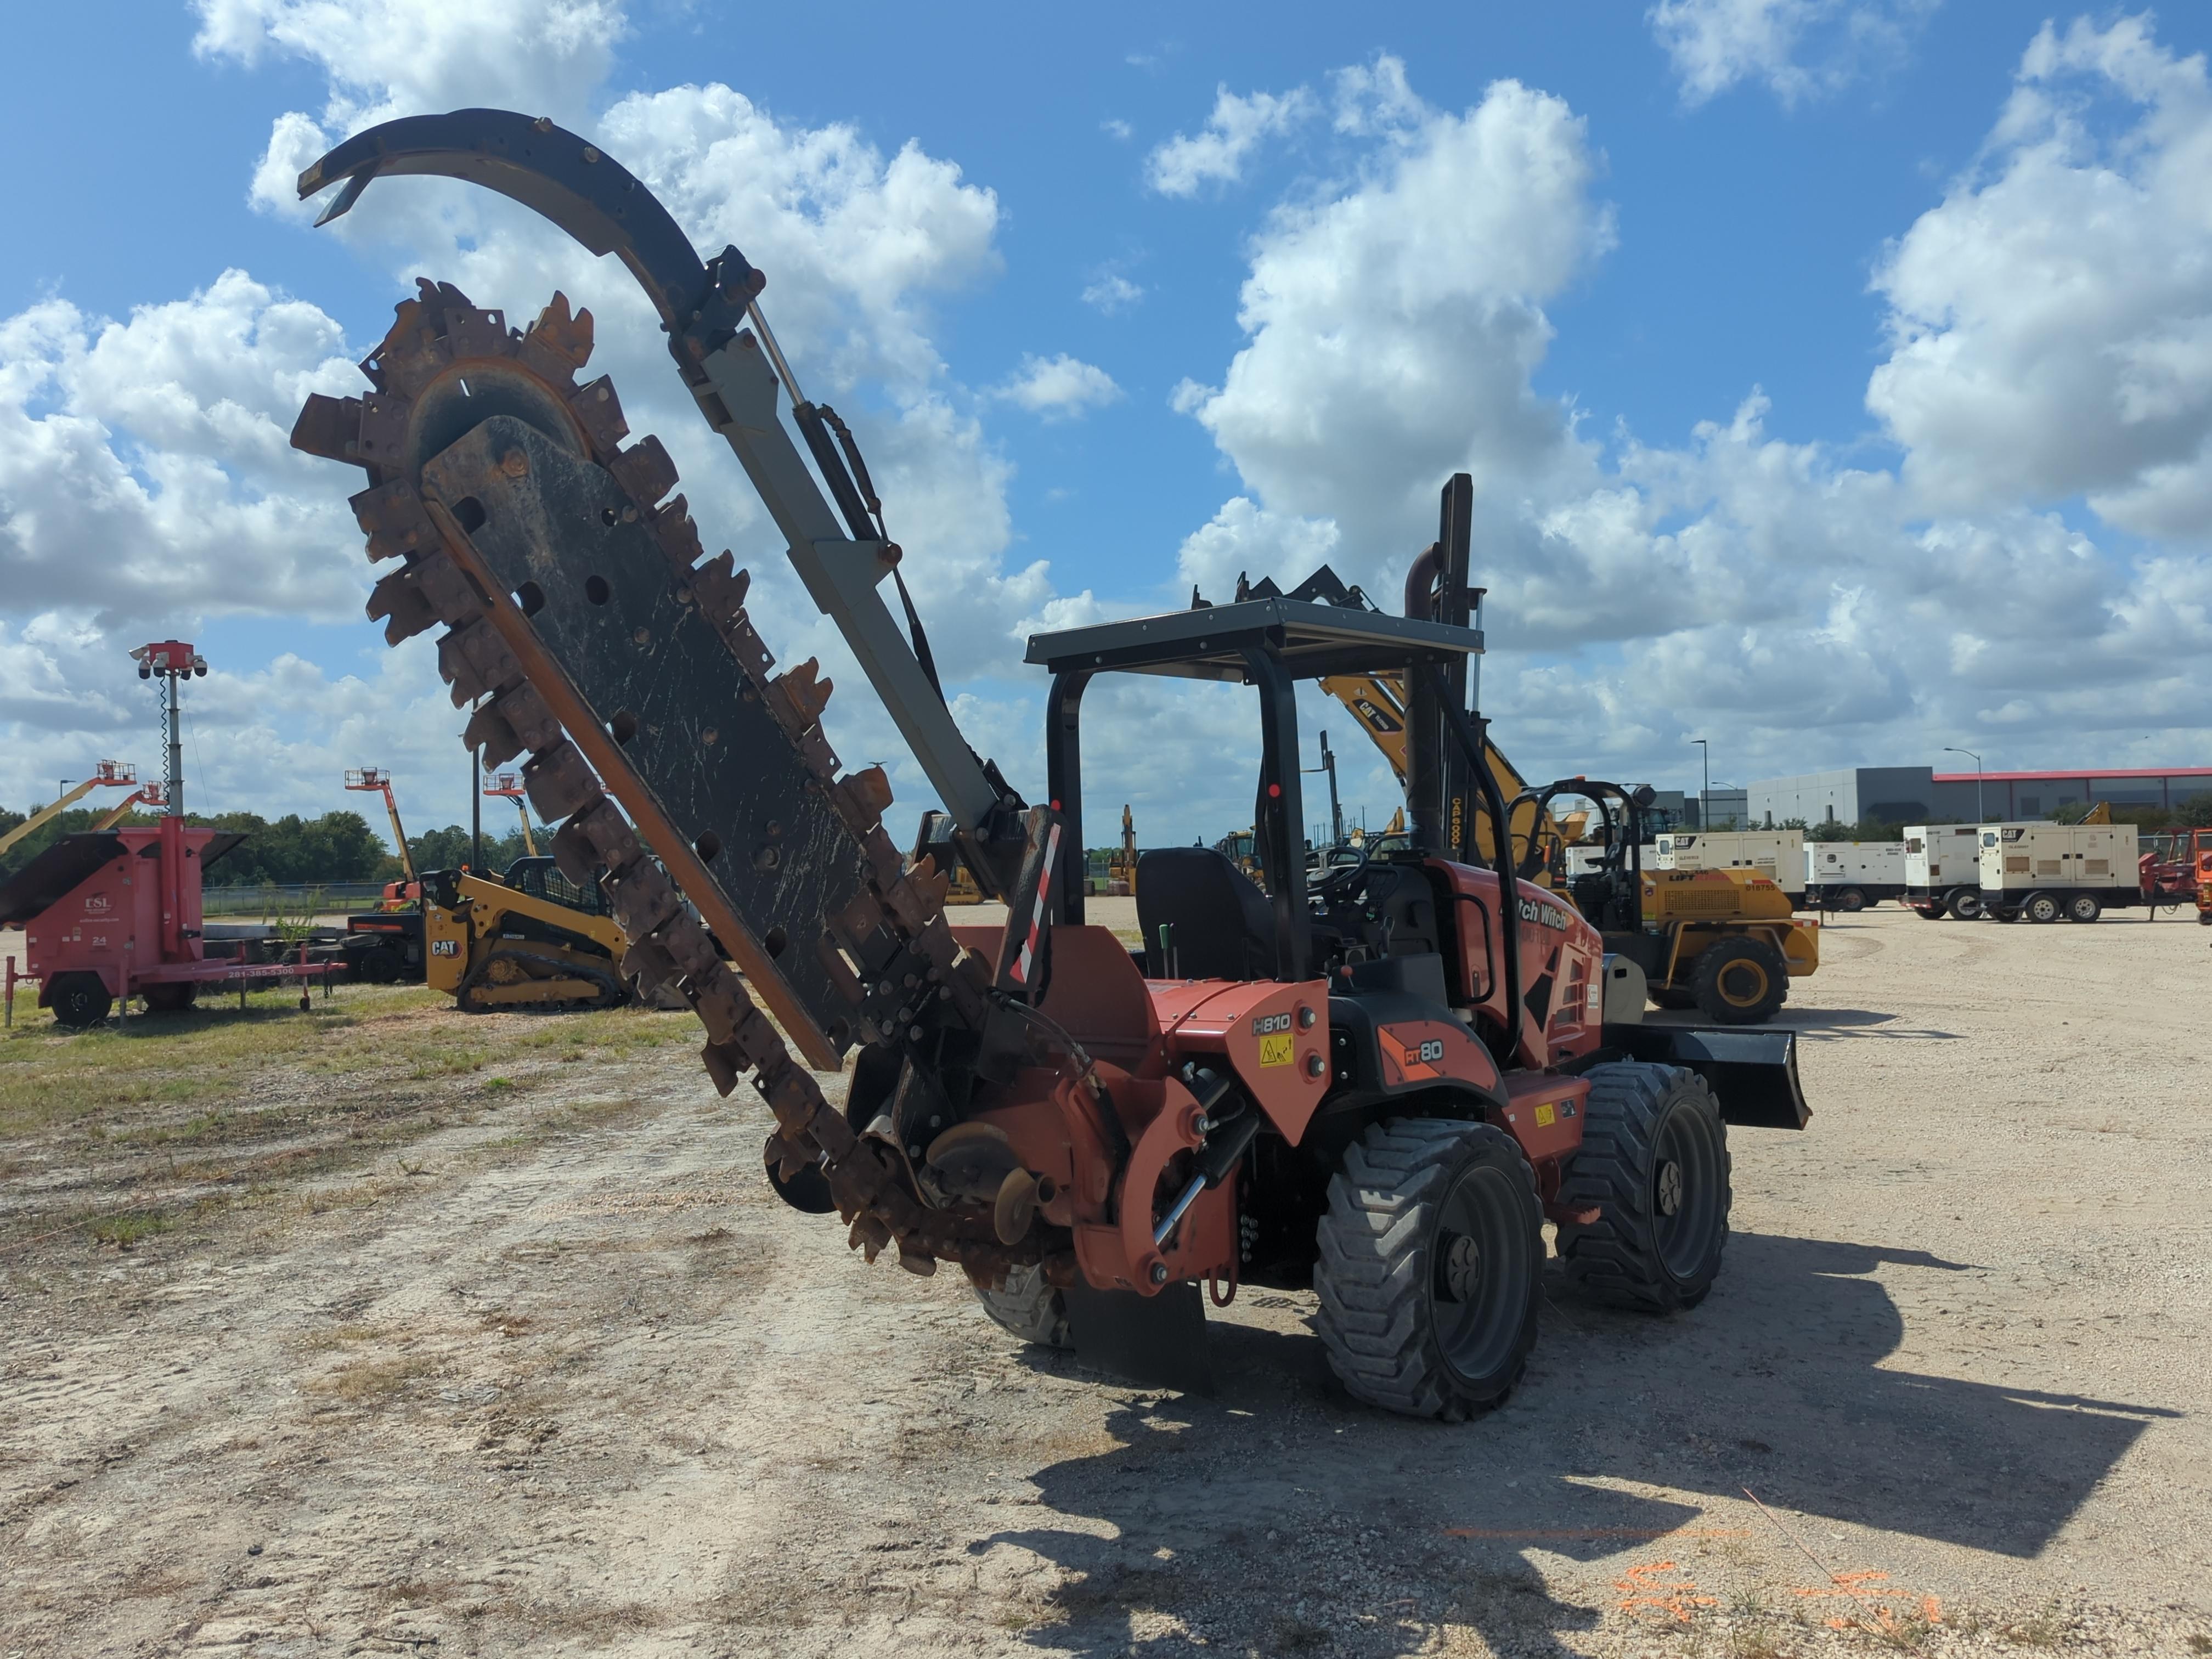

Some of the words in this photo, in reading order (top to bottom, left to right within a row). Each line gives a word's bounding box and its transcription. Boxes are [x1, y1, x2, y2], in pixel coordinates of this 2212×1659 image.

[1359, 702, 1376, 718] CAT
[1675, 837, 1690, 845] CAT
[2002, 830, 2017, 838] CAT
[86, 898, 112, 908] ESL
[1541, 903, 1567, 930] Witch
[432, 941, 455, 955] CAT
[228, 967, 295, 978] 281-385-5300
[1252, 1013, 1291, 1035] H810
[1406, 1041, 1442, 1064] RT80
